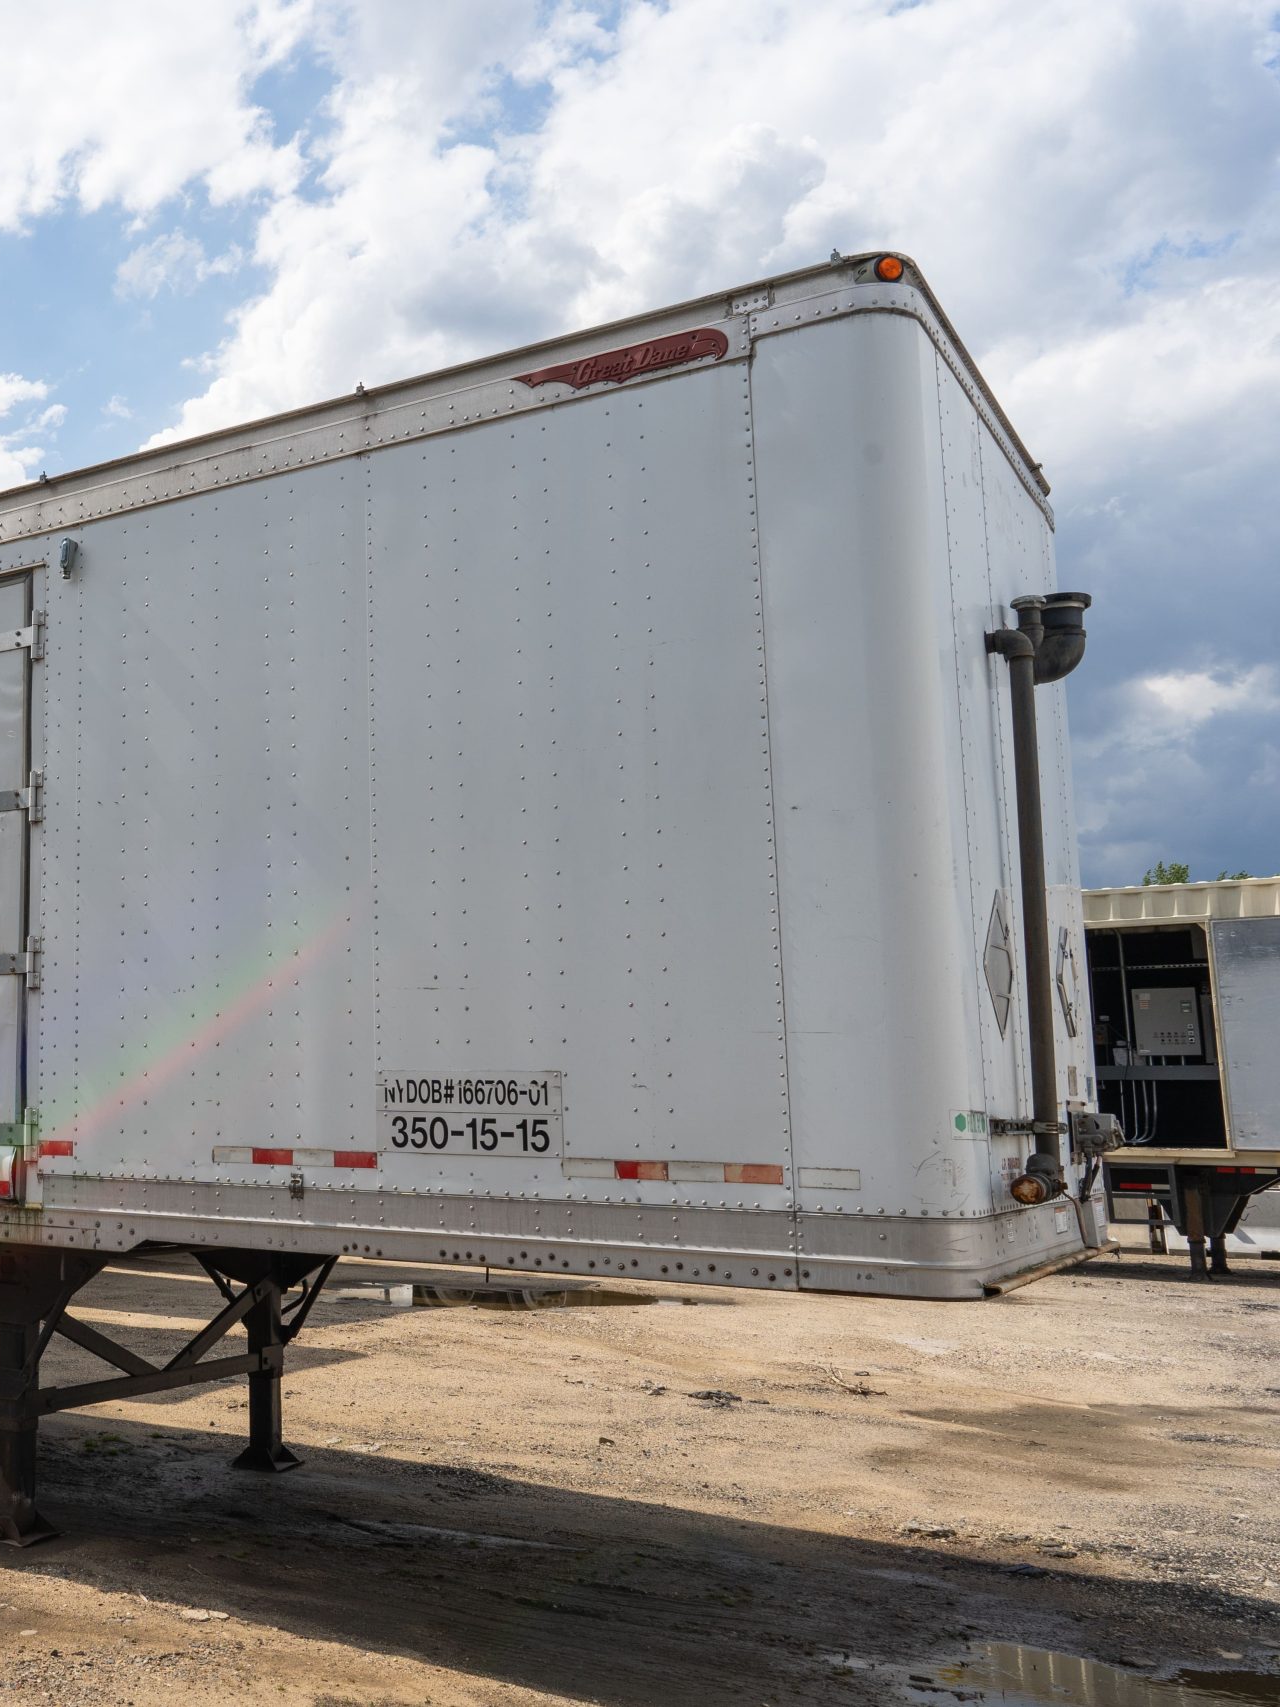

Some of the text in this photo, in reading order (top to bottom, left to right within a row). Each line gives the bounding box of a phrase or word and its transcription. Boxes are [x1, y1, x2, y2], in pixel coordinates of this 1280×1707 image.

[576, 344, 688, 385] Great Dane
[391, 1116, 550, 1153] 350-15-15
